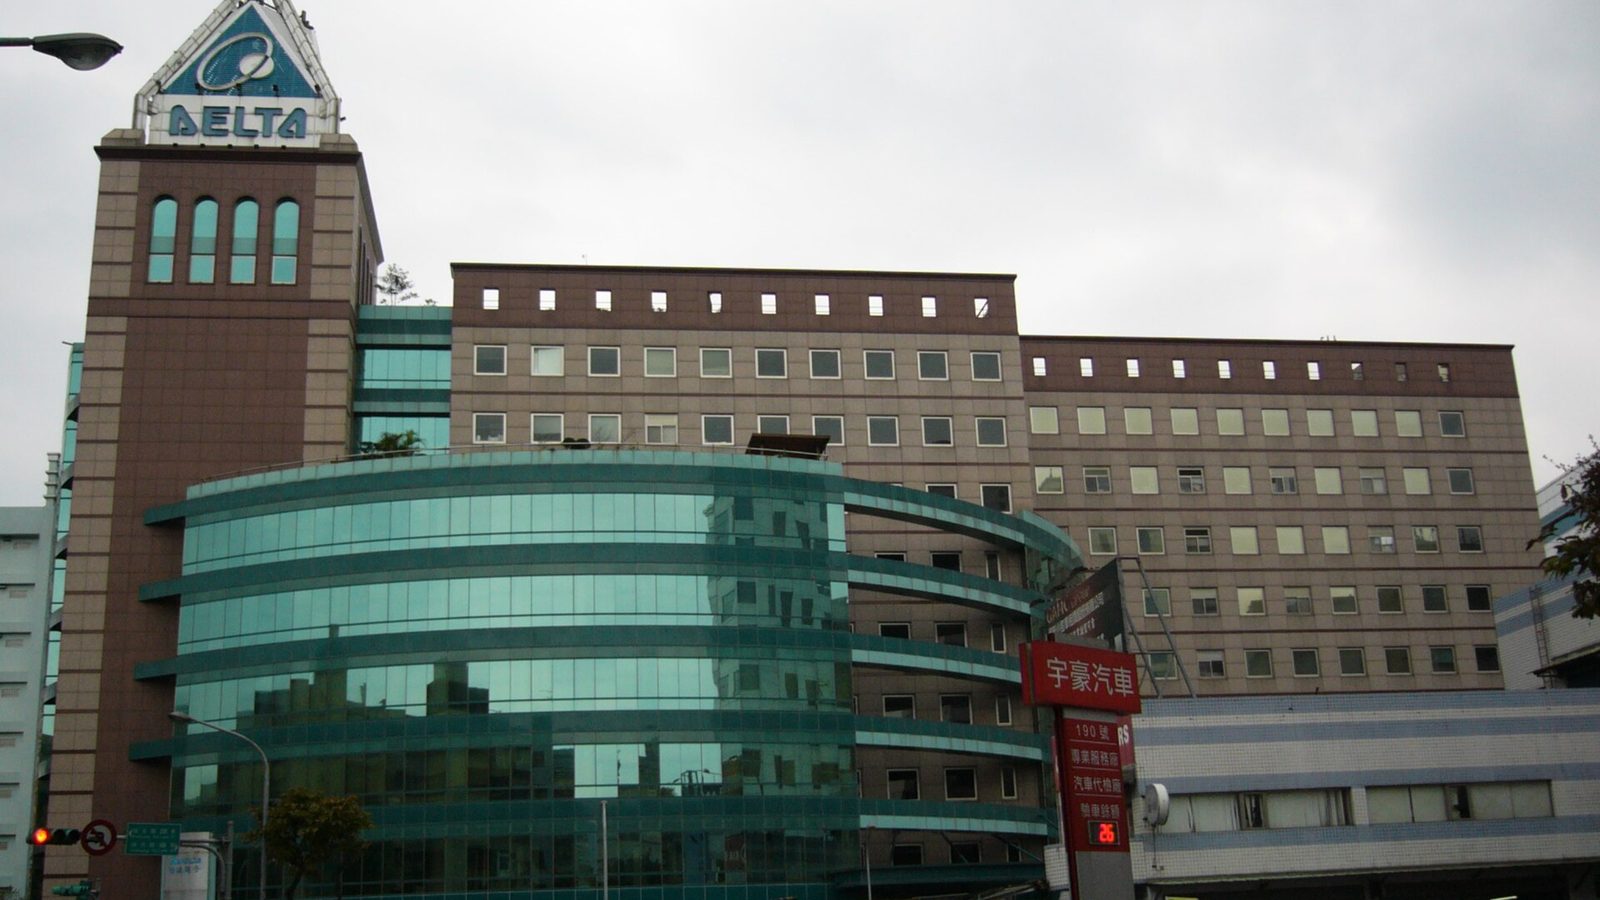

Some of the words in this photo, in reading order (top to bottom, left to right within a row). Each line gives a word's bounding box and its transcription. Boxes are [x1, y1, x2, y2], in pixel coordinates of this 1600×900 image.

[169, 104, 306, 139] DELTA
[1046, 657, 1134, 697] 宇豪汽車
